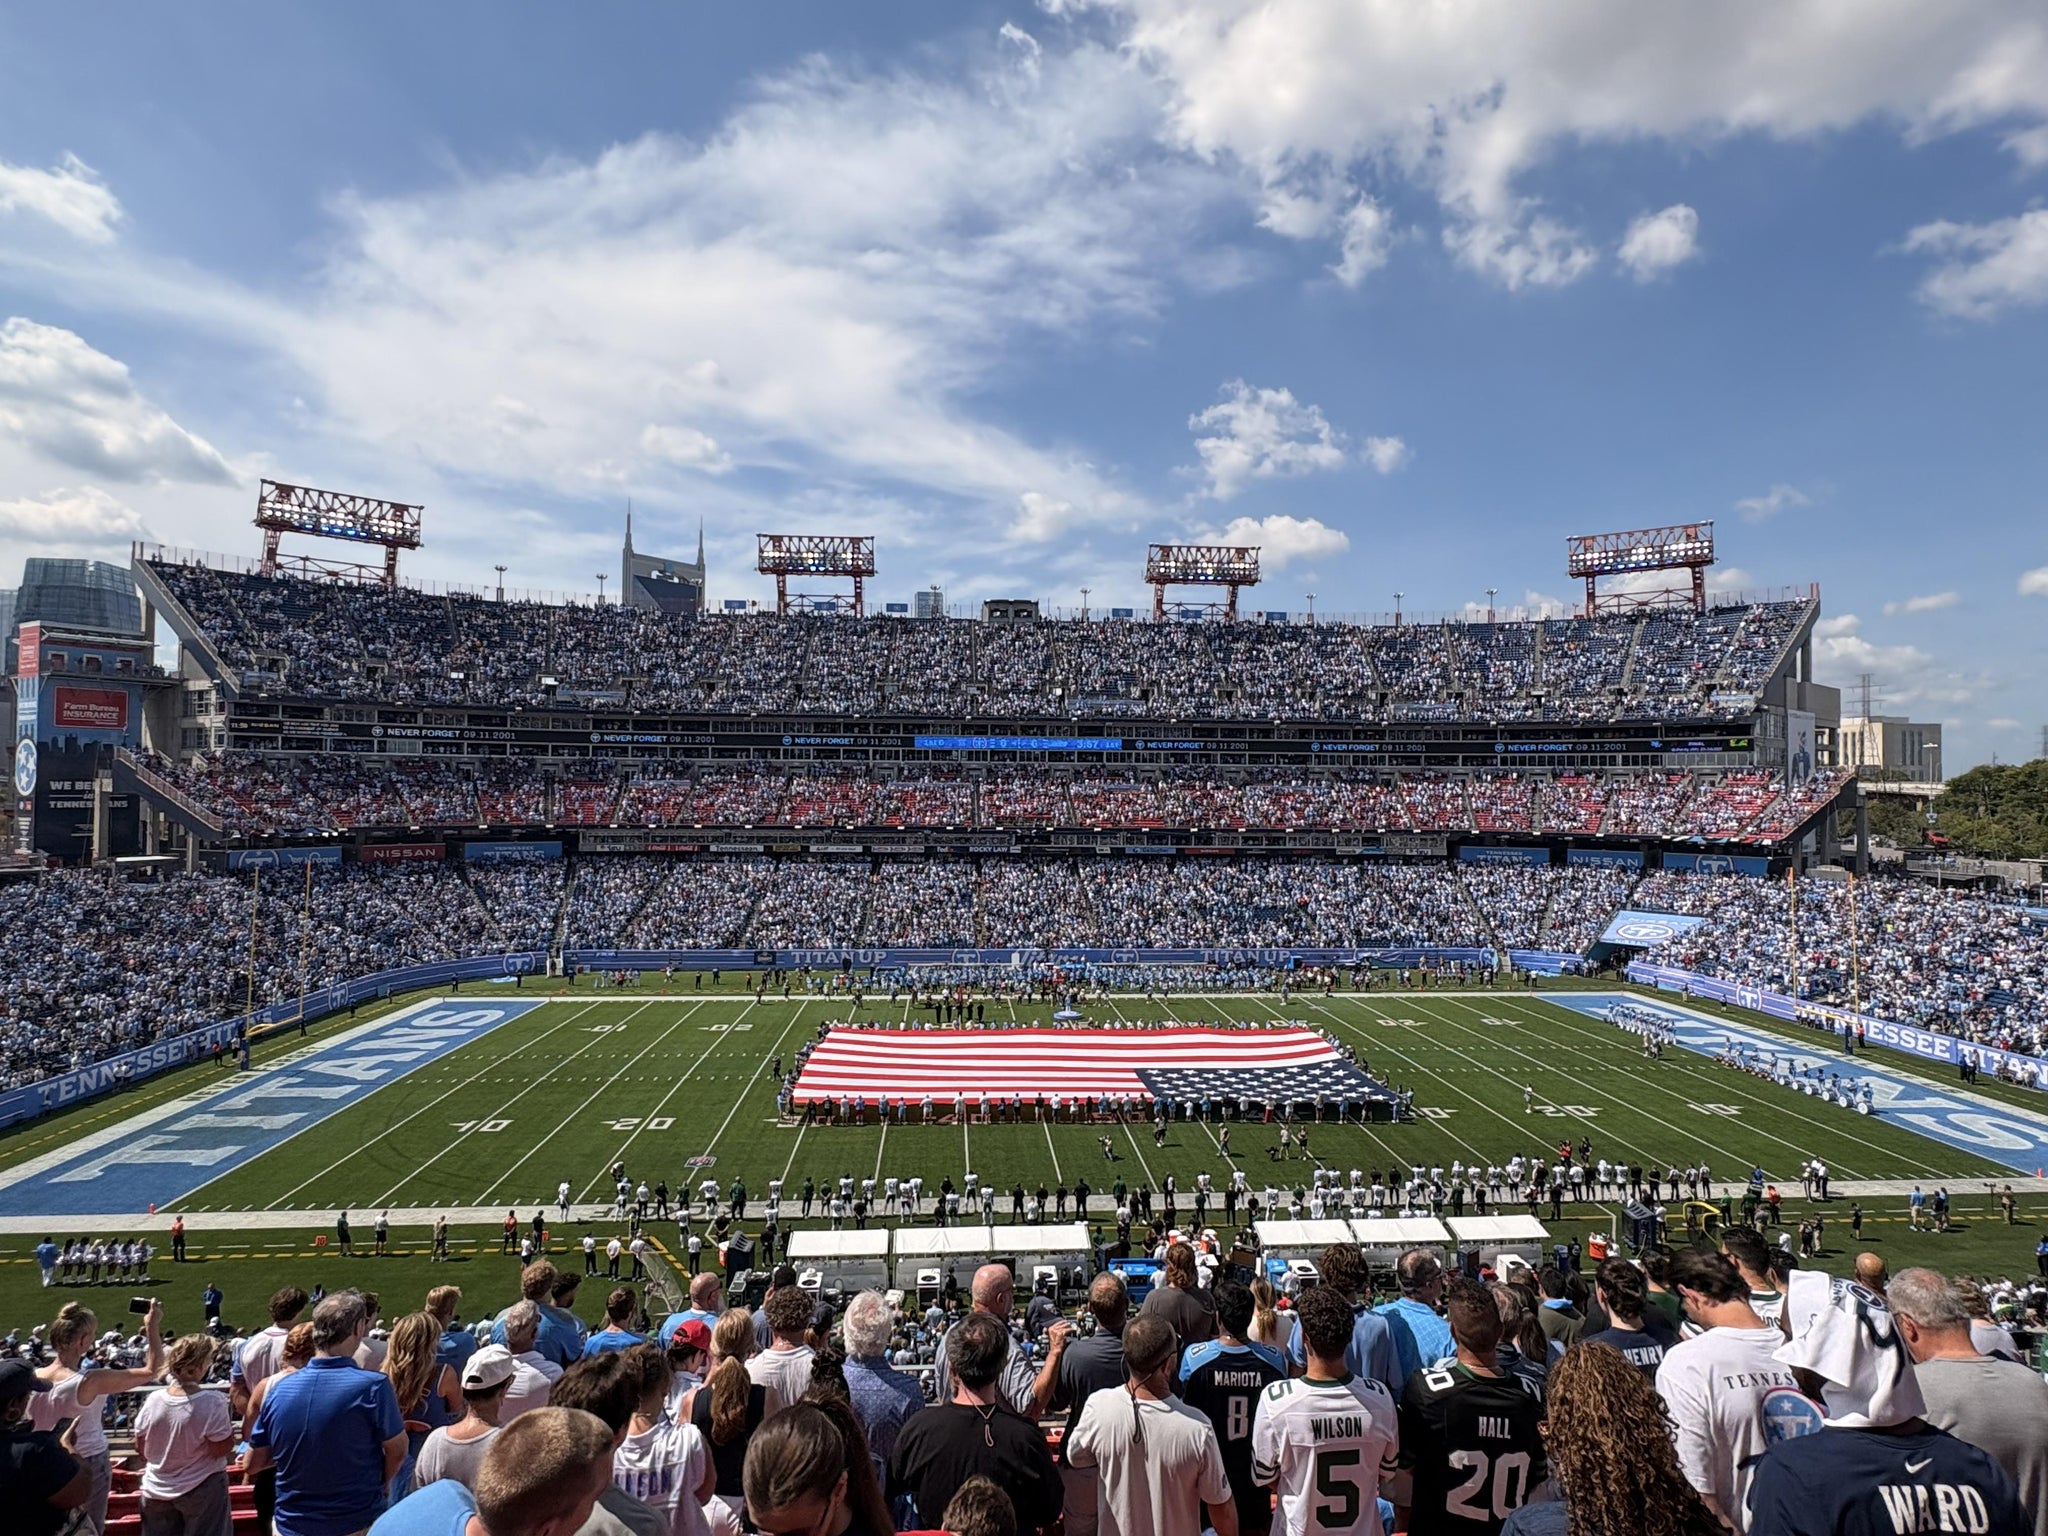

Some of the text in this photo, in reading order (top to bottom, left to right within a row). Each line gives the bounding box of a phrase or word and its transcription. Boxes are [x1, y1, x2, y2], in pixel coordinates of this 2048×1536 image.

[64, 702, 120, 712] Farm Bureau
[62, 710, 119, 720] INSURANCE
[387, 728, 420, 737] NEVER
[421, 729, 460, 738] FORGET
[603, 734, 632, 742] NEVER
[633, 735, 667, 743] FORGET
[1173, 742, 1204, 750] FORGET
[49, 781, 72, 790] WE
[373, 849, 436, 858] NISSAN
[1572, 856, 1639, 867] NISSAN
[791, 951, 887, 964] TITAN UP
[1201, 951, 1290, 964] TITAN UP
[48, 1009, 505, 1184] TITANS
[1533, 1104, 1598, 1118] 20
[1687, 1102, 1739, 1116] 10
[458, 1119, 514, 1132] 10
[611, 1117, 677, 1130] 20
[1623, 1344, 1664, 1366] HENRY
[1214, 1370, 1262, 1388] MARIOTA
[1267, 1380, 1293, 1402] 5
[1227, 1395, 1249, 1441] 8
[1309, 1415, 1363, 1440] WILSON
[1478, 1415, 1511, 1440] HALL
[1315, 1449, 1360, 1529] 5
[1445, 1449, 1531, 1522] 20
[1877, 1484, 1989, 1535] WARD
